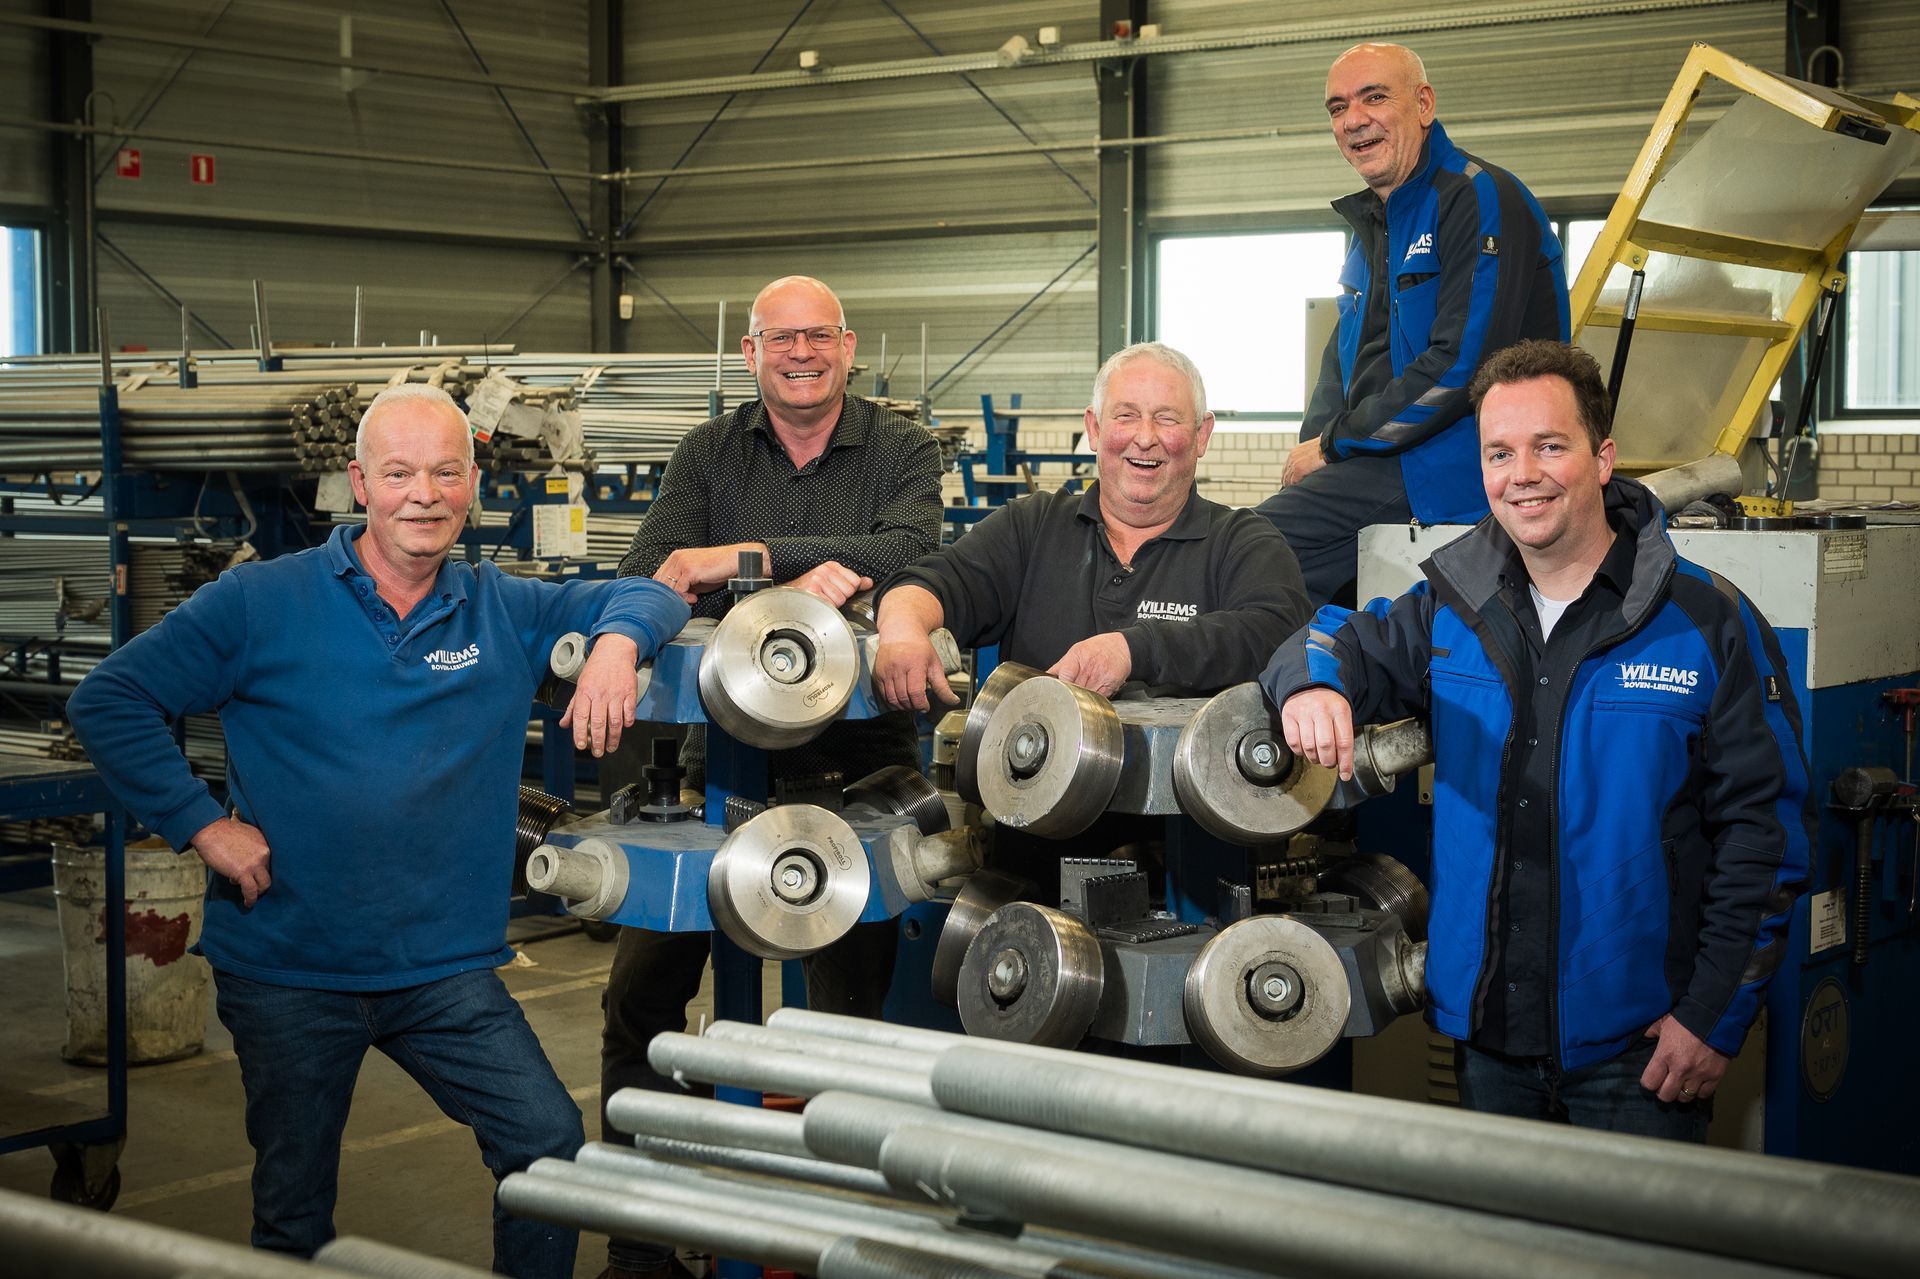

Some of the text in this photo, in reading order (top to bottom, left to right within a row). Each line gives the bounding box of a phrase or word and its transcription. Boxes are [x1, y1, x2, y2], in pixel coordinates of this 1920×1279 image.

[1136, 600, 1198, 617] WILLEMS
[423, 643, 480, 664] WILLEMS
[1621, 662, 1699, 687] WILLEMS
[1623, 681, 1690, 695] BOVEN-LEEUWEN
[826, 836, 847, 867] PROFIROLL
